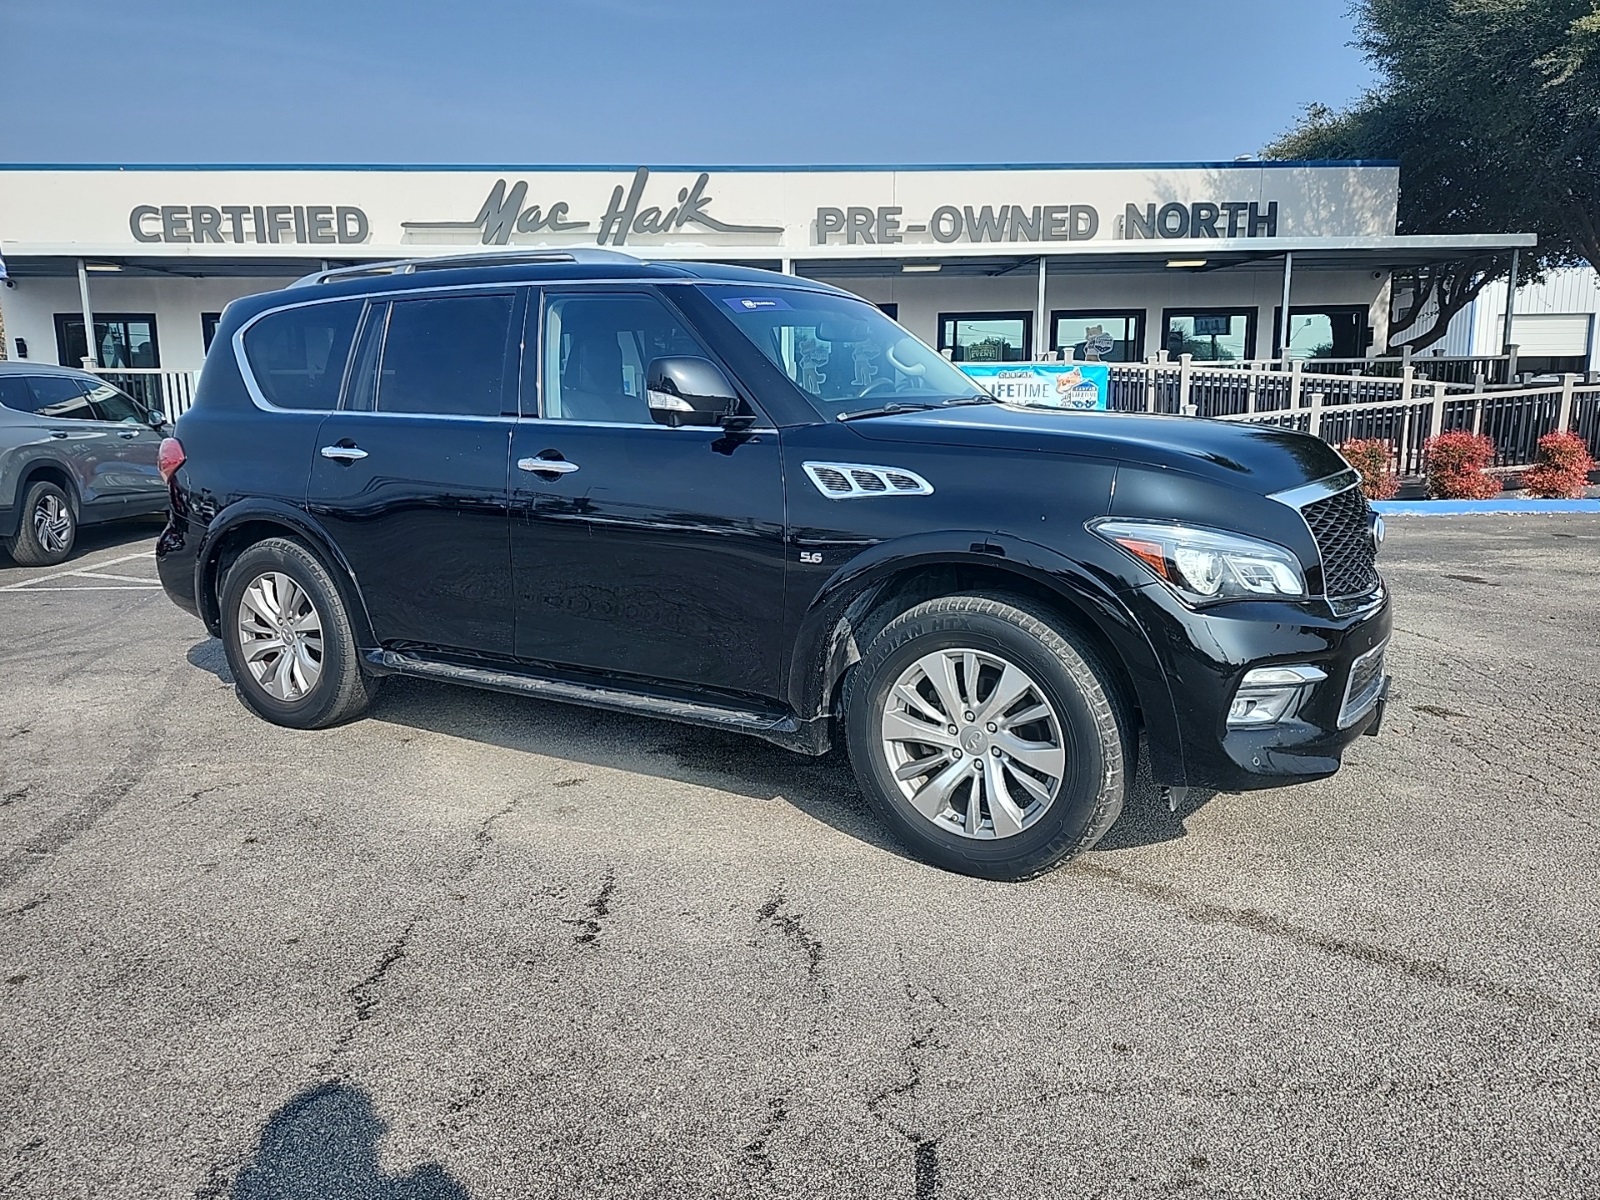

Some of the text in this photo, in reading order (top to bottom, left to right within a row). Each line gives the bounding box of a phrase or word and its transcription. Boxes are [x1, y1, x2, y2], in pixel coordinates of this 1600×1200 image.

[129, 205, 369, 244] CERTIFIED
[401, 166, 785, 246] Mac Haik
[816, 202, 1278, 244] PRE-OWNED NORTH
[982, 383, 1050, 398] IFETIME
[931, 617, 972, 632] HTX
